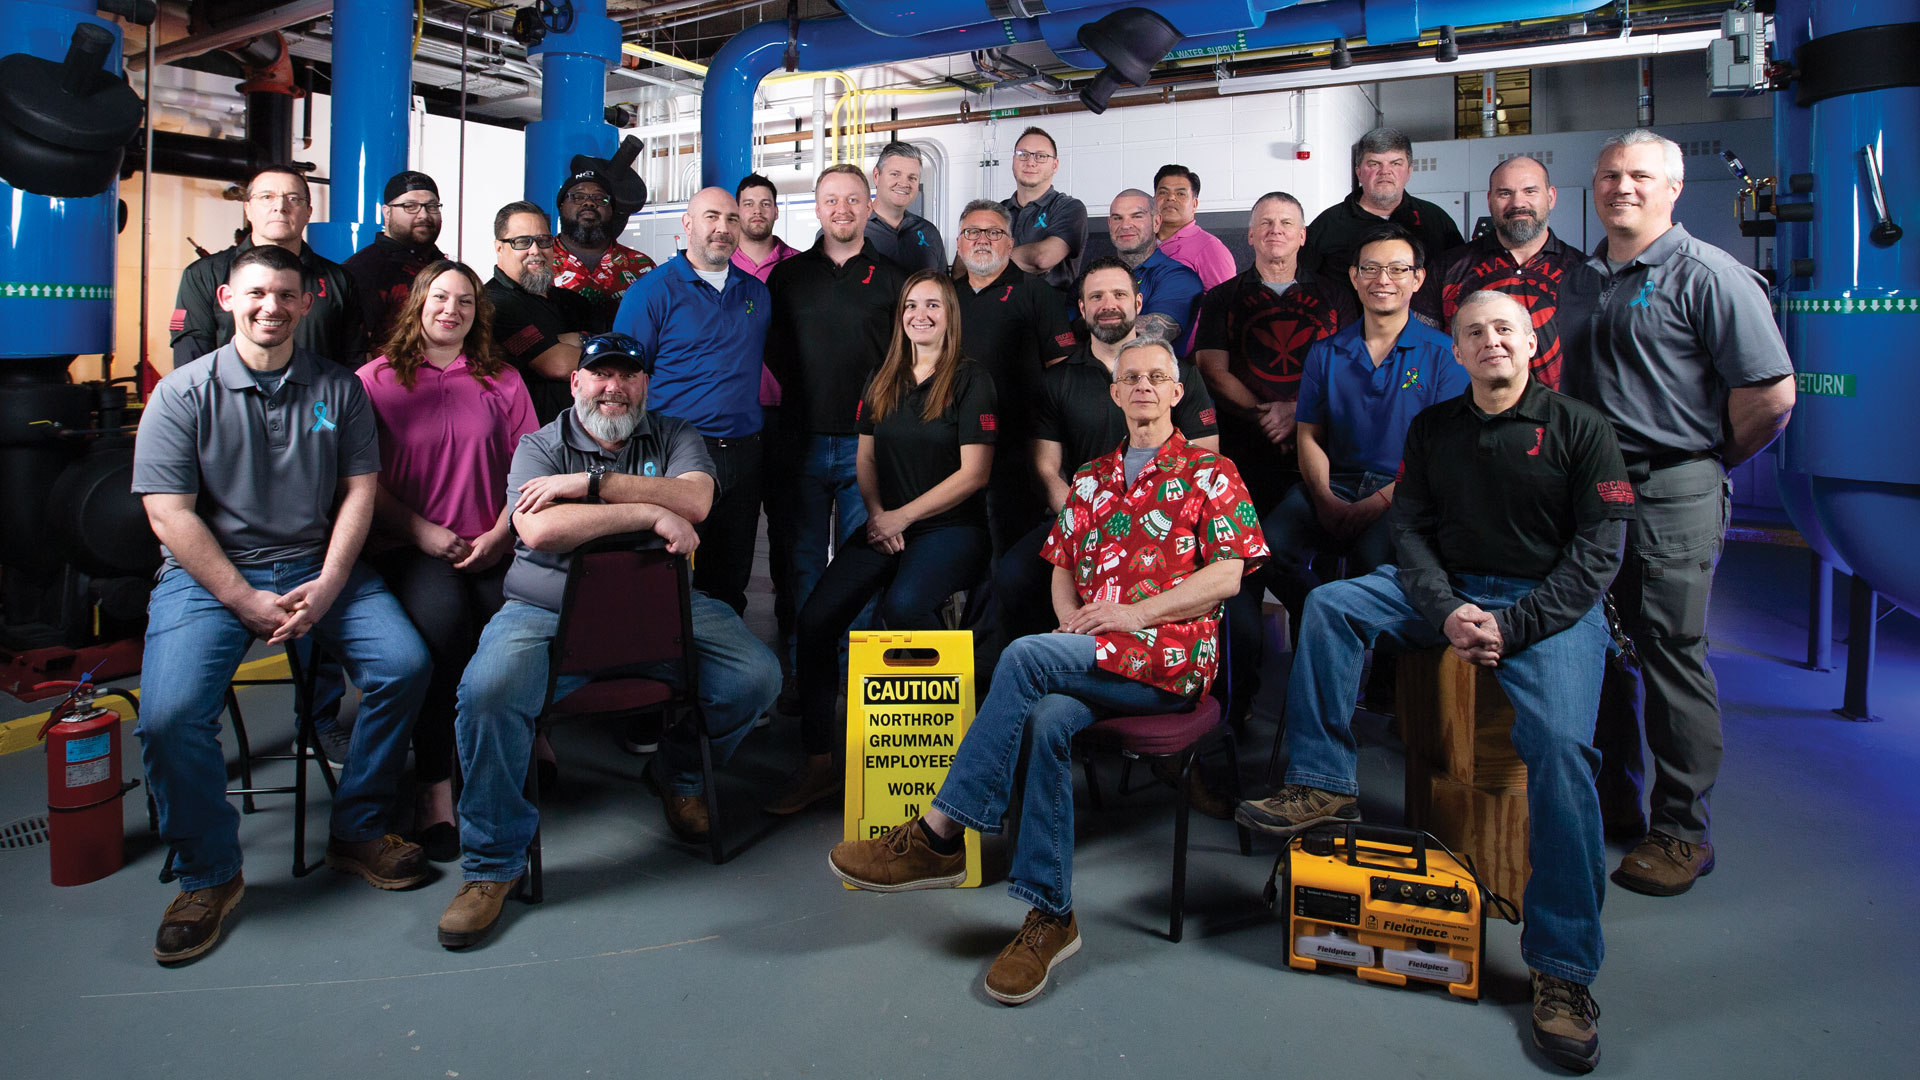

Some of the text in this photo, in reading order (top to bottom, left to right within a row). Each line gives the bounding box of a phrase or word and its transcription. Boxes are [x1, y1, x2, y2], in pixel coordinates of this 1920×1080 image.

[1176, 48, 1203, 58] WATER
[1207, 44, 1237, 55] SUPPLY
[867, 680, 957, 700] CAUTION
[869, 713, 954, 726] NORTHROP
[869, 734, 954, 747] GRUMMAN
[866, 755, 956, 768] EMPLOYEES
[888, 782, 936, 795] WORK
[904, 804, 919, 817] IN
[869, 826, 898, 838] PR
[1383, 920, 1448, 939] Fieldpiece
[1317, 945, 1356, 957] Fieldpiece
[1408, 960, 1448, 972] Fieldpiece
